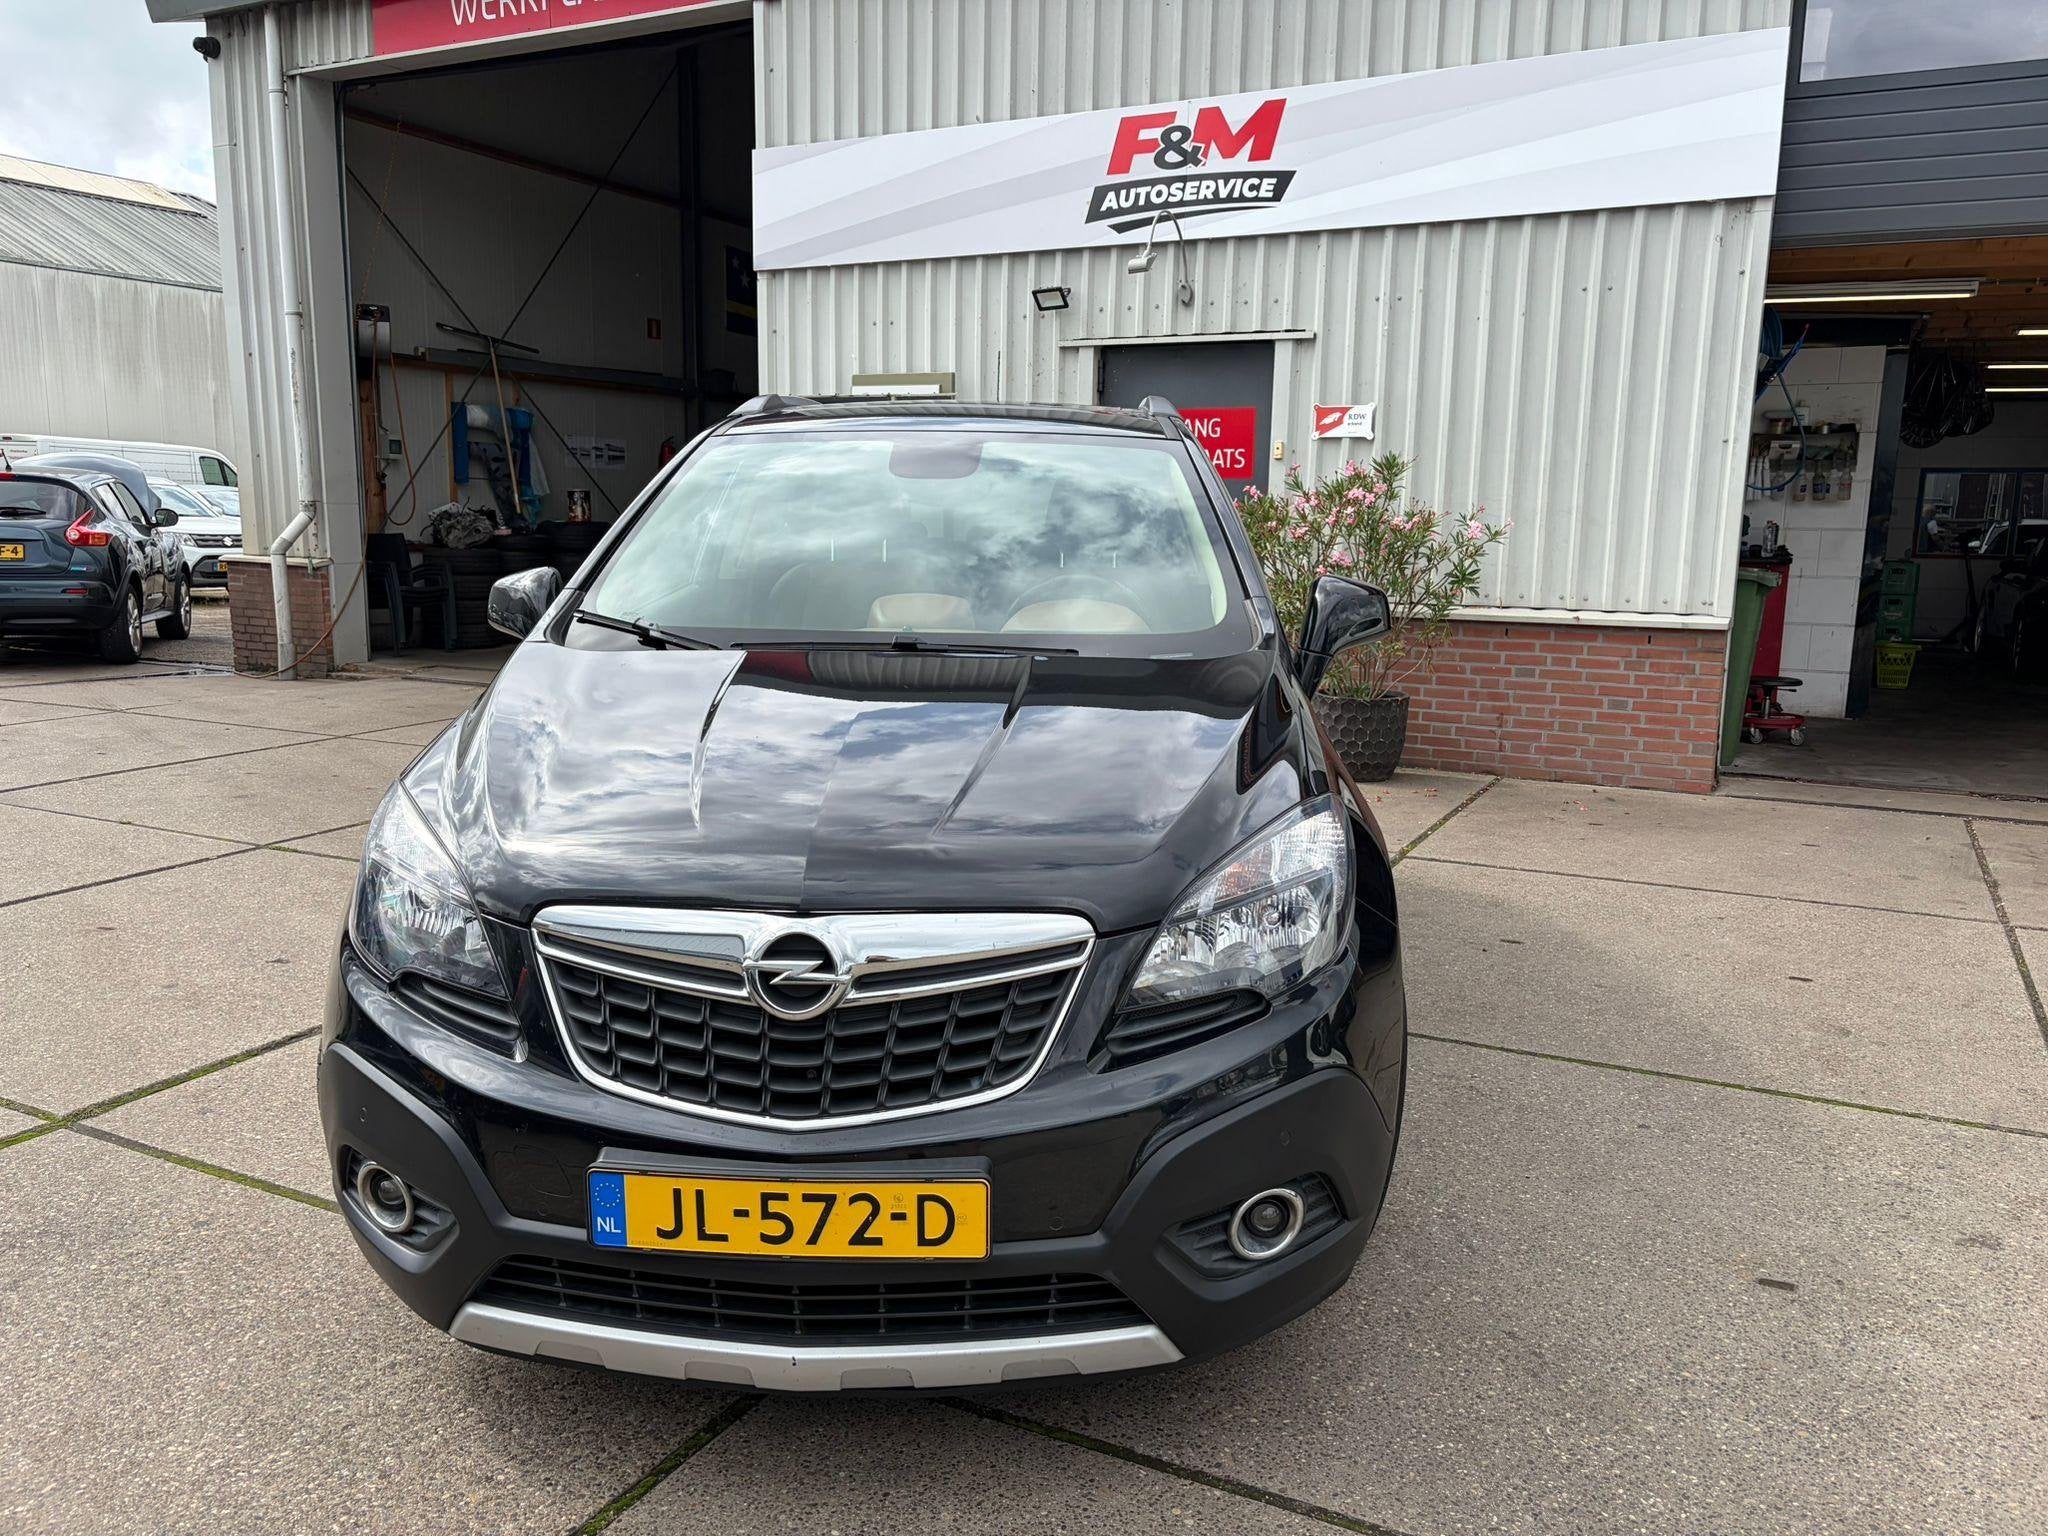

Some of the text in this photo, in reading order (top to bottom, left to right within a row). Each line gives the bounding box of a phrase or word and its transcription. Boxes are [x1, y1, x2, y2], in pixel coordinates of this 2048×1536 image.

[1107, 98, 1288, 176] F&M
[1100, 177, 1278, 212] AUTOSERVICE
[1204, 448, 1246, 469] ATS
[597, 1216, 622, 1233] NL
[656, 1187, 956, 1247] JL-572-D
